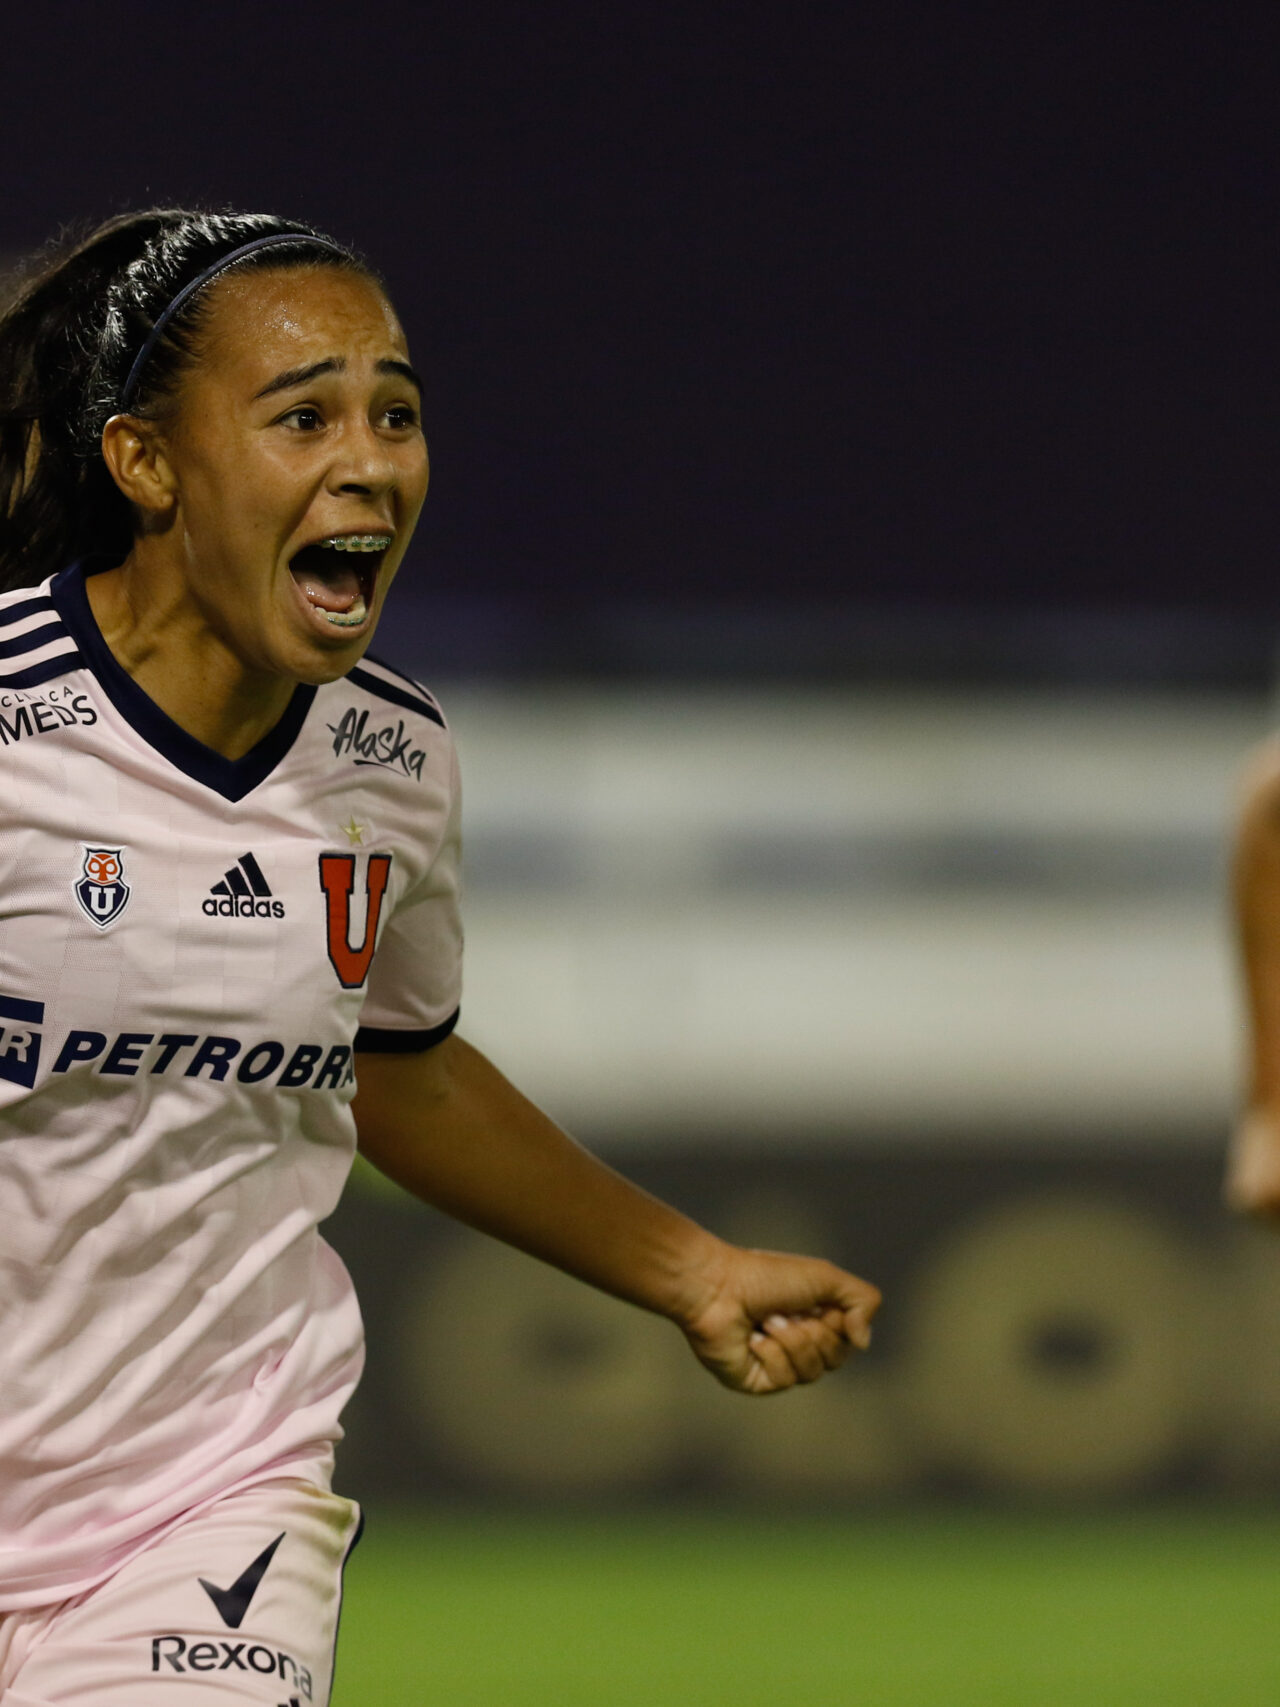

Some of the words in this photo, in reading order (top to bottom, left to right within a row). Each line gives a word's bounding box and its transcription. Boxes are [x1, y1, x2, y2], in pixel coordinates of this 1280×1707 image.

[326, 707, 426, 782] Alaska
[88, 886, 117, 916] U
[202, 894, 286, 919] adidas
[319, 853, 393, 989] U
[152, 1636, 313, 1702] Rexona
